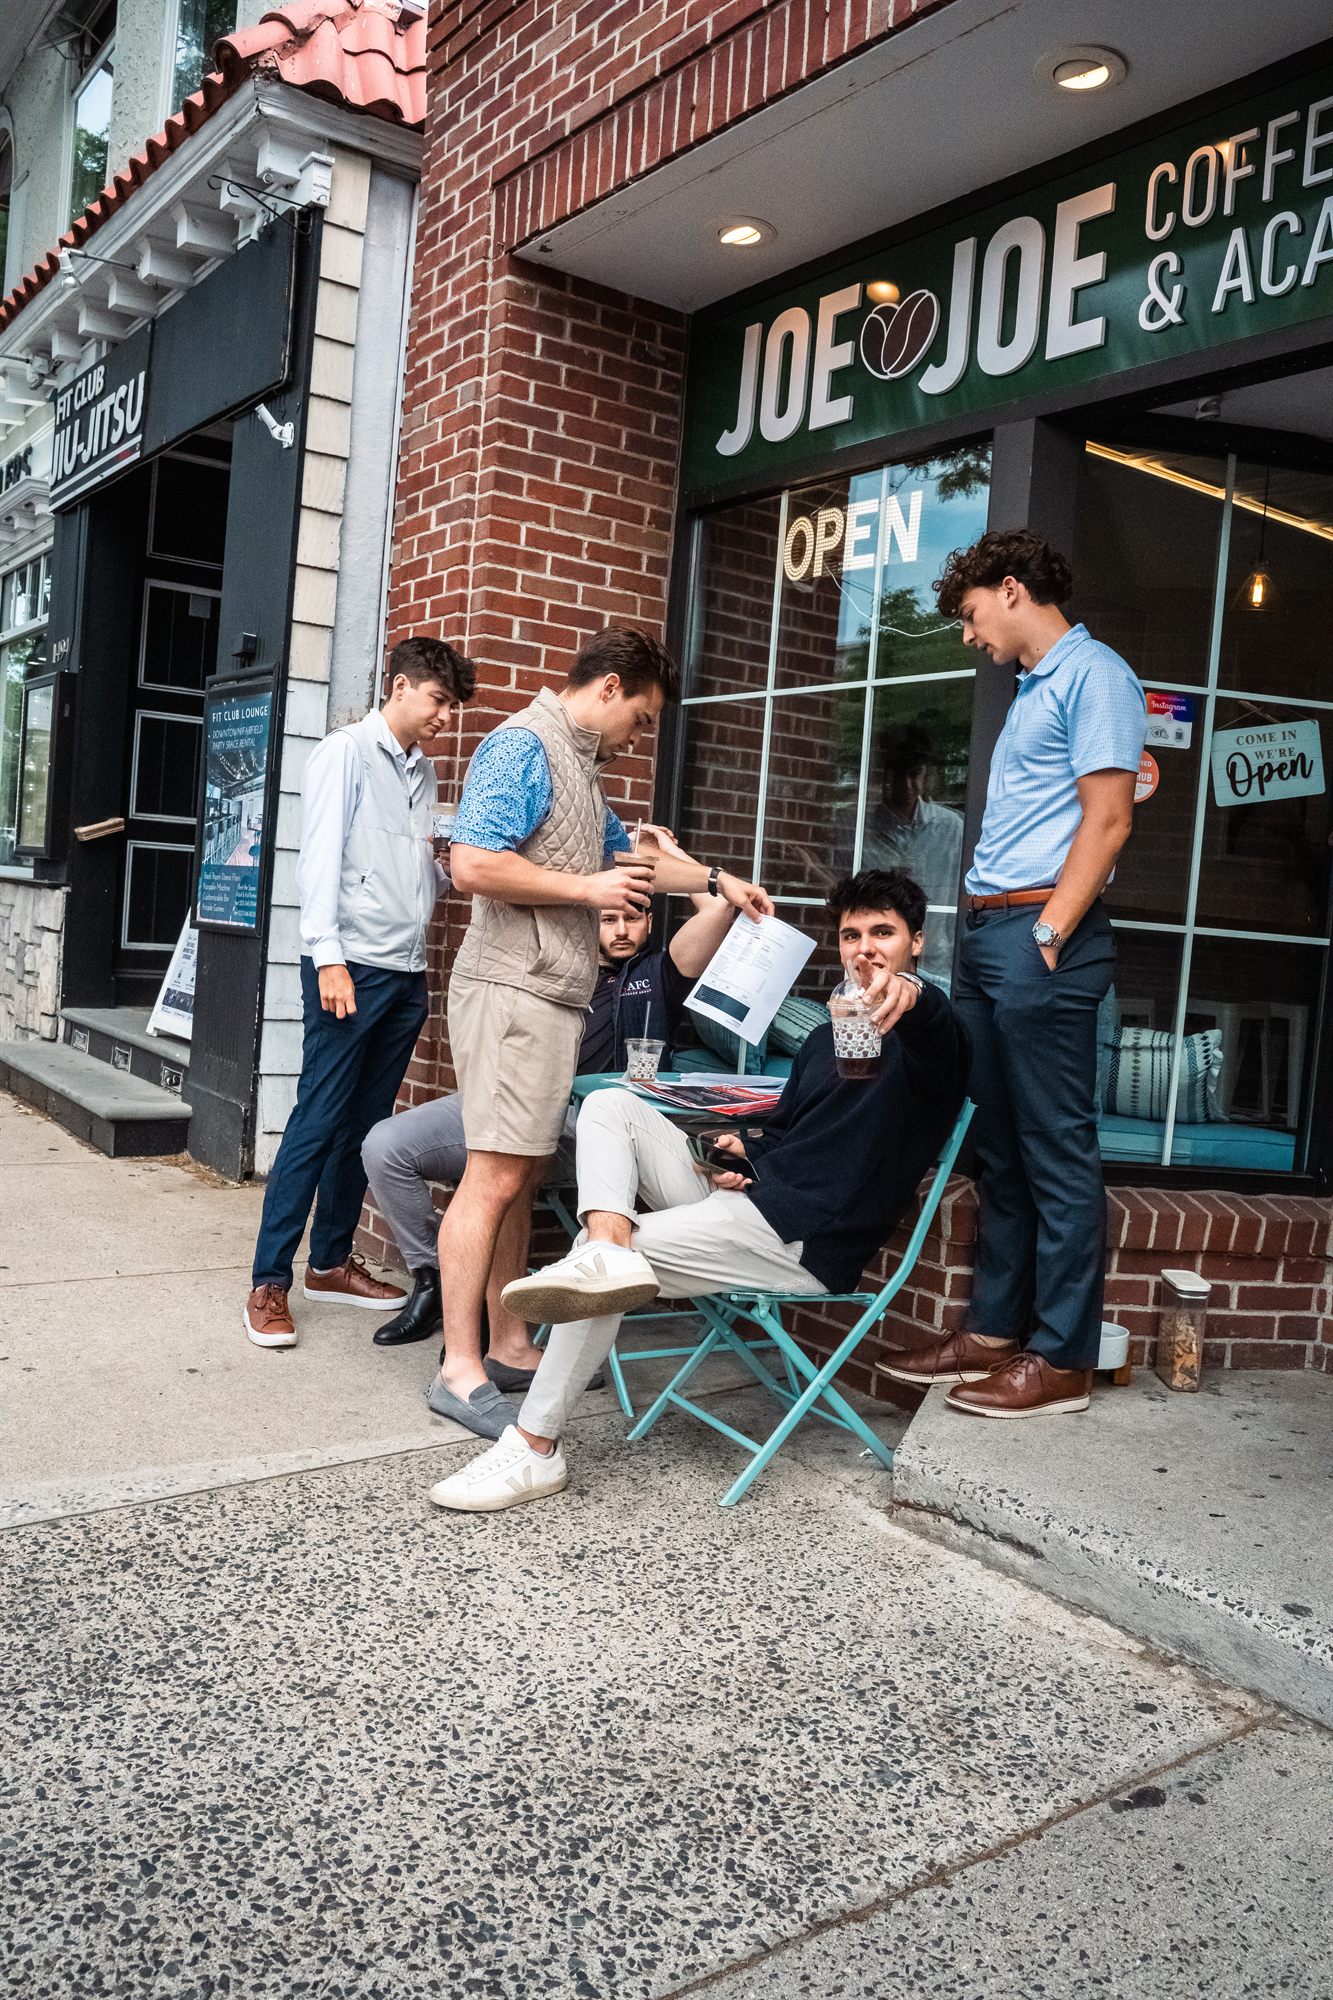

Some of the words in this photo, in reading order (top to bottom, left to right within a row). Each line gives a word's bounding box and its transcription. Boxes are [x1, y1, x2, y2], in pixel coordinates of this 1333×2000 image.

[1138, 251, 1186, 332] &
[715, 283, 865, 457] JOE
[918, 182, 1117, 395] JOE
[56, 387, 74, 426] FIT
[74, 364, 106, 411] CLUB
[48, 370, 146, 486] JIU-JITSU
[783, 490, 923, 582] OPEN
[212, 711, 223, 724] FIT
[223, 708, 240, 722] CLUB
[241, 705, 269, 719] LOUNGE
[1151, 700, 1187, 713] Instagram
[1235, 732, 1277, 746] COME
[1282, 729, 1297, 741] IN
[1254, 746, 1296, 760] WE'RE
[1225, 751, 1314, 797] Open
[627, 978, 651, 991] AFC
